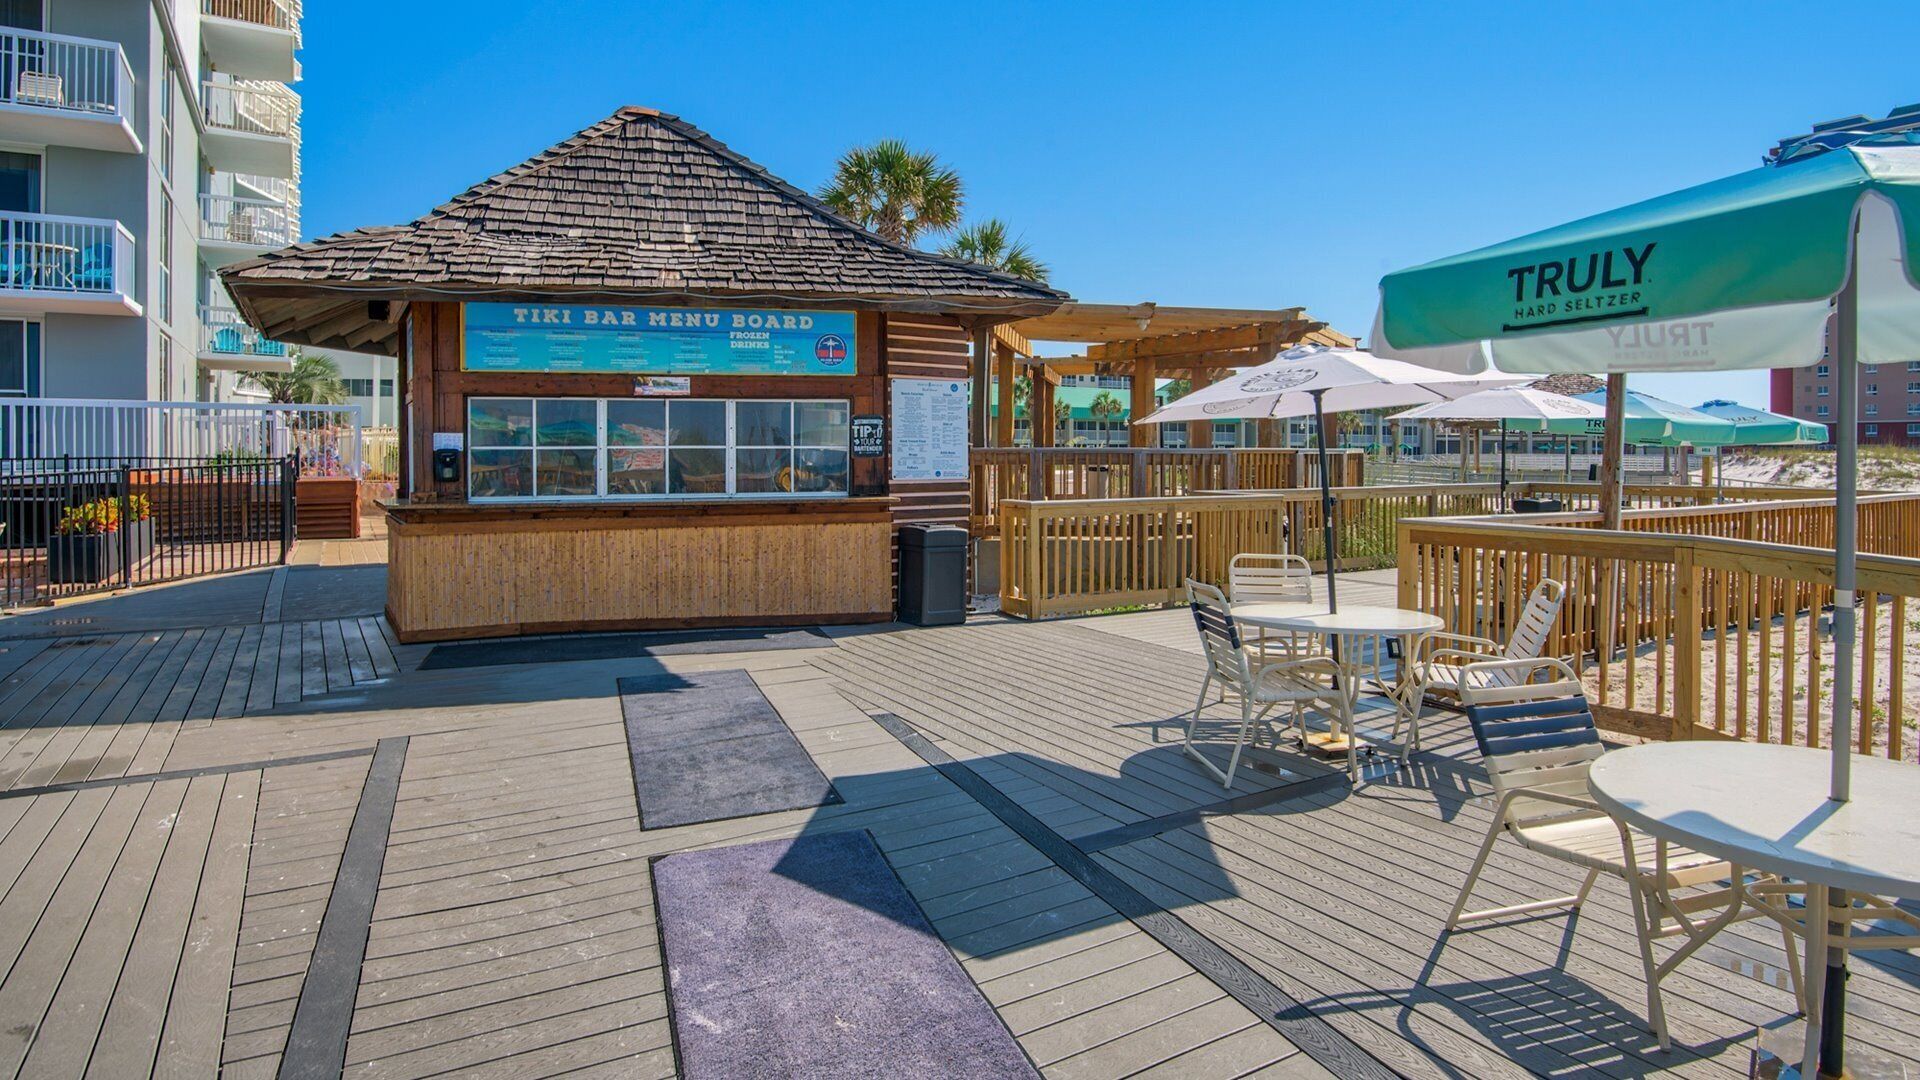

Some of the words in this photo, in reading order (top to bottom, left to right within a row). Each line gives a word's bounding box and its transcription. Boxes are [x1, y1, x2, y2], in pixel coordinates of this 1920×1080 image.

[1507, 242, 1657, 302] TRULY
[1514, 303, 1557, 320] HARD
[1564, 291, 1642, 313] SELTZER
[513, 308, 572, 324] TIKI
[584, 310, 637, 326] BAR
[648, 312, 721, 328] MENU
[732, 314, 814, 330] BOARD
[729, 331, 770, 340] FROZEN
[729, 340, 770, 349] DRINKS
[852, 425, 872, 438] TIP
